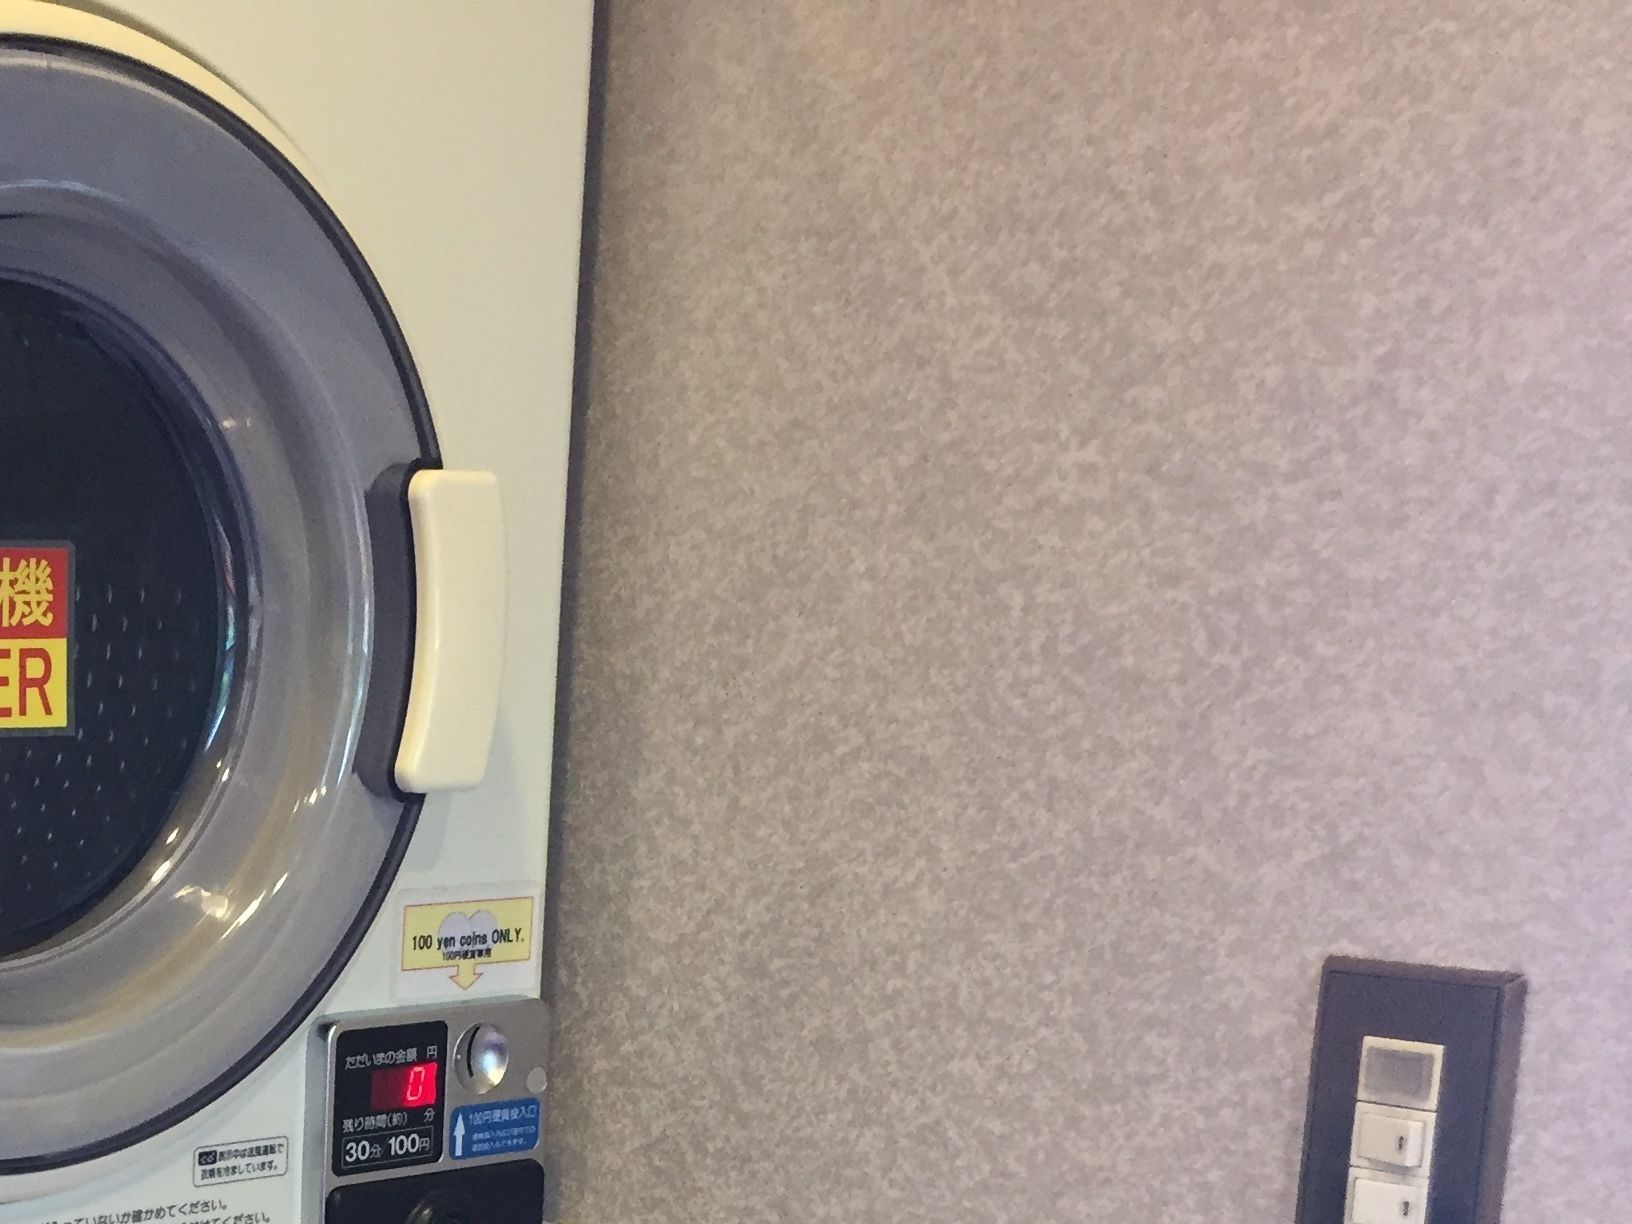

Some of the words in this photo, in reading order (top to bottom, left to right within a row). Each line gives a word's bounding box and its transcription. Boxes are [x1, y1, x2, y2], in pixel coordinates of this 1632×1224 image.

[413, 935, 433, 950] 100
[437, 936, 456, 950] yen
[460, 932, 487, 946] coins
[345, 1049, 417, 1070] ただいまの金額
[427, 1046, 438, 1058] 円
[406, 1067, 425, 1100] 0
[342, 1112, 408, 1133] 残り時間（約）
[424, 1109, 436, 1123] 分
[345, 1140, 382, 1163] 30分
[388, 1133, 430, 1155] 100円
